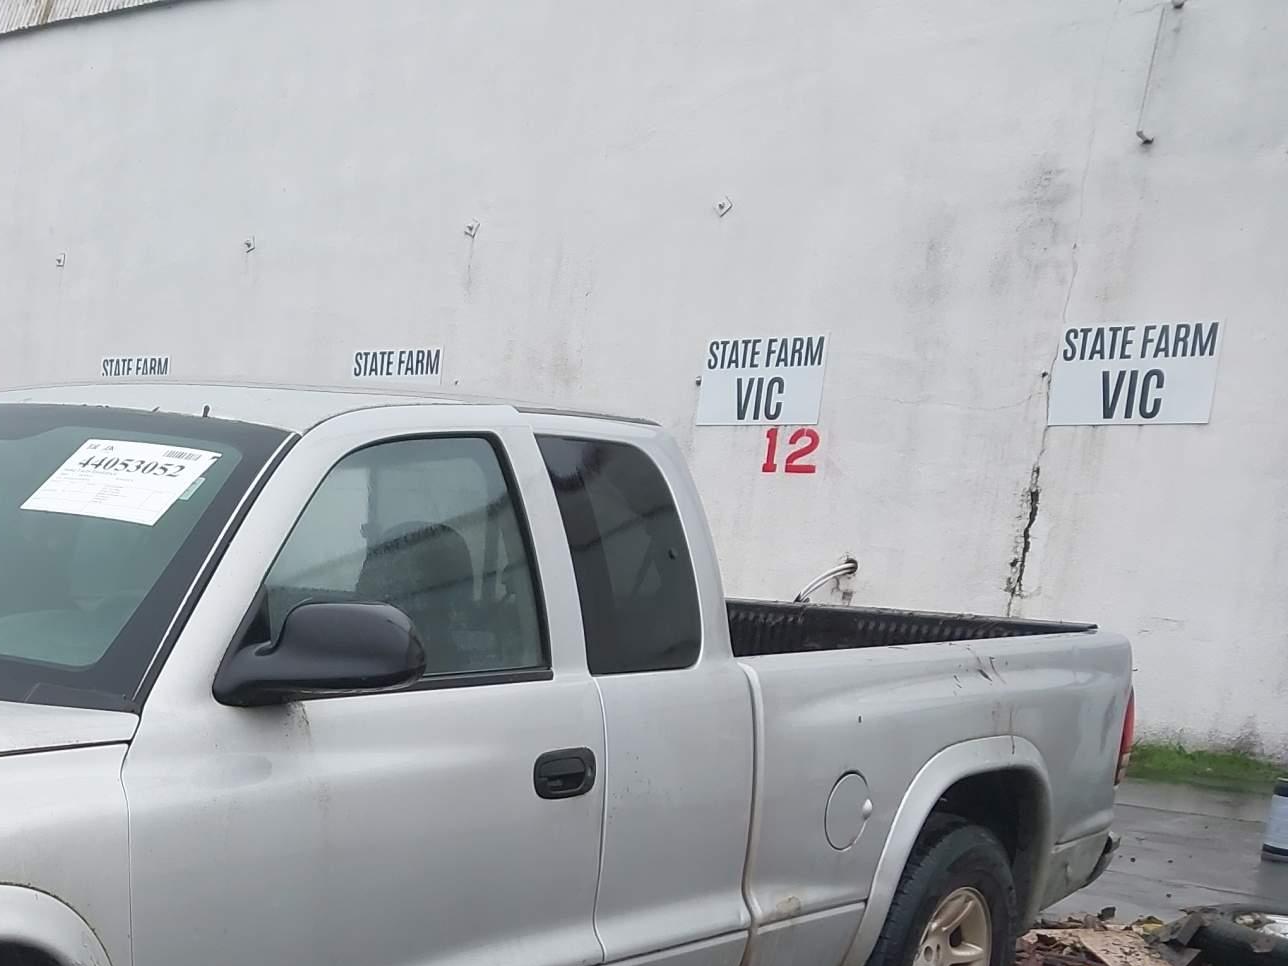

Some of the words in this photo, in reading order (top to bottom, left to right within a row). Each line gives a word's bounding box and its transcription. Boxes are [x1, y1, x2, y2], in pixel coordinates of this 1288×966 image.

[707, 339, 761, 370] STATE
[765, 336, 825, 367] FARM
[1062, 326, 1136, 361] STATE
[1140, 322, 1219, 359] FARM
[102, 358, 133, 377] STATE
[135, 357, 169, 375] FARM
[353, 351, 394, 377] STATE
[397, 349, 440, 375] FARM
[735, 377, 785, 420] VIC
[1101, 369, 1165, 419] VIC
[79, 455, 186, 478] 44053052
[761, 427, 820, 474] 12
